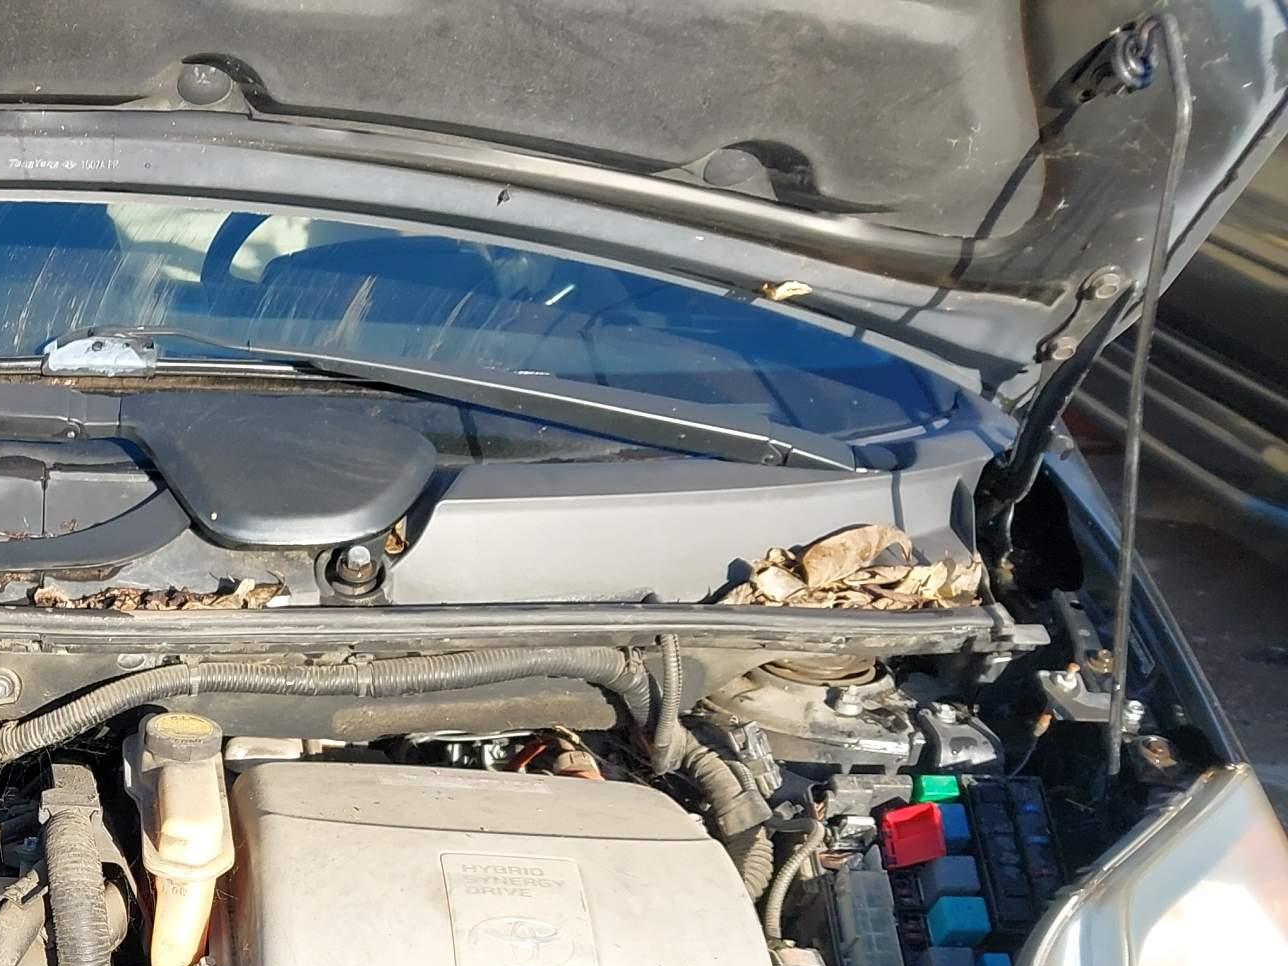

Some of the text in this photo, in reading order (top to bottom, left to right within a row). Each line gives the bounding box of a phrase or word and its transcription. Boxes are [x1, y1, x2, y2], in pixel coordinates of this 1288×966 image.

[462, 863, 545, 877] HYBRID
[463, 875, 566, 889] SYNERGY
[465, 886, 533, 898] DRIVE
